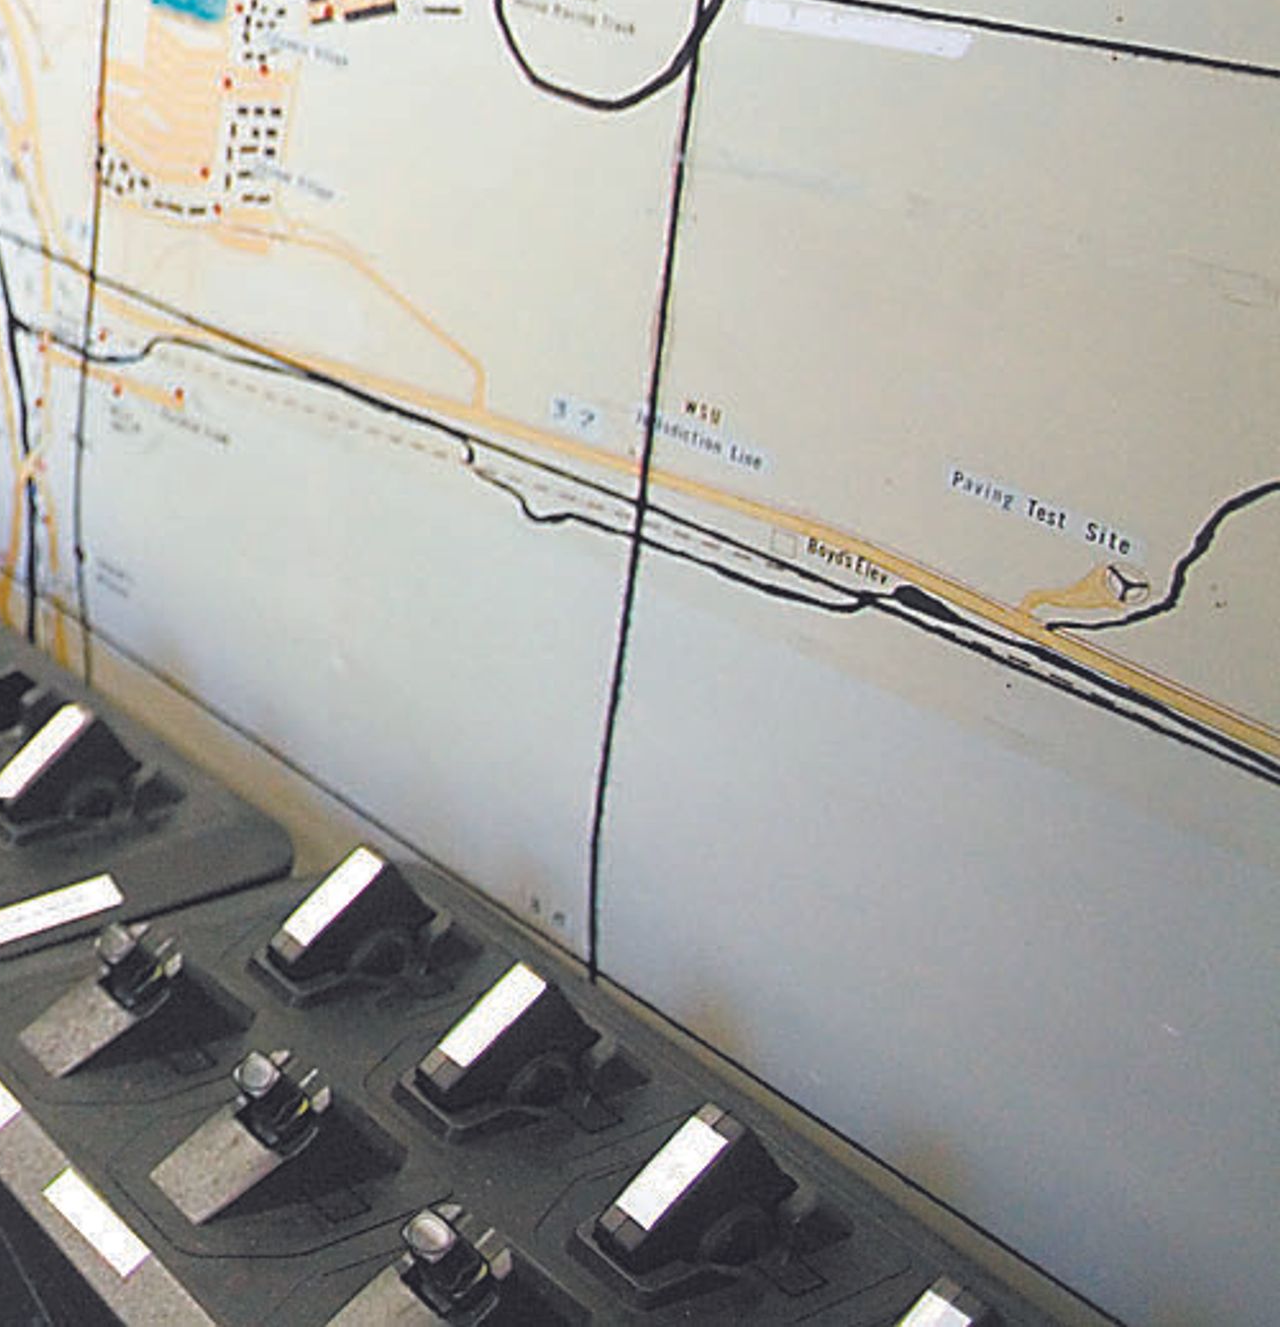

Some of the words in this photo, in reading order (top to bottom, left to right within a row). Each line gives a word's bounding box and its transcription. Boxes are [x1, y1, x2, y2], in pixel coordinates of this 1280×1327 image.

[684, 398, 724, 427] WSU
[951, 469, 1014, 512] Paving
[1026, 500, 1068, 531] Test
[1085, 522, 1134, 556] Site
